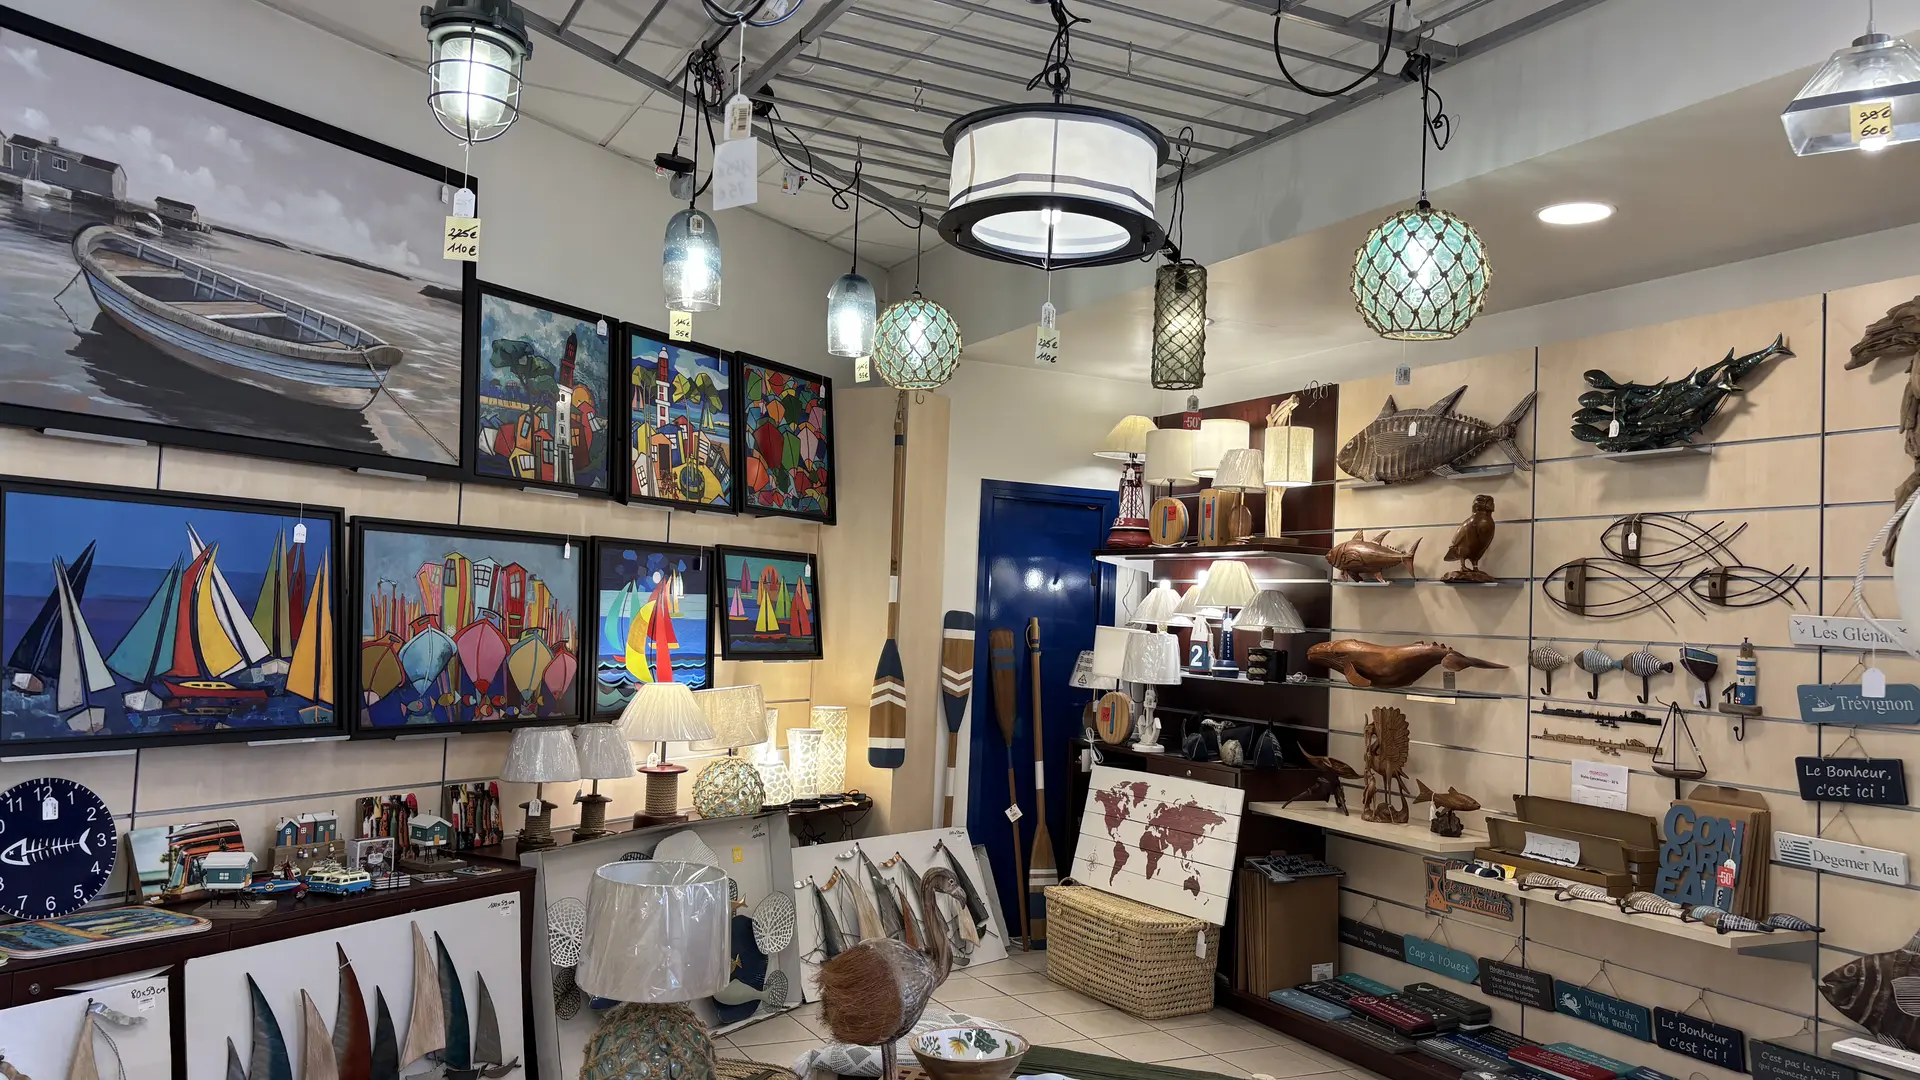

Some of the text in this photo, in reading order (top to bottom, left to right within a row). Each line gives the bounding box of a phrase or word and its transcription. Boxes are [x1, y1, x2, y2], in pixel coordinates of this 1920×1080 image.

[1861, 125, 1890, 136] 60€
[448, 226, 478, 240] 225€
[447, 243, 477, 256] 110€
[1037, 352, 1057, 363] 110€
[1812, 625, 1838, 640] Les
[1190, 645, 1203, 666] 2
[1837, 696, 1914, 714] Trévignon
[1805, 765, 1891, 780] Le Bonheur,
[67, 791, 74, 805] 1
[1816, 784, 1850, 797] c'est
[1857, 784, 1874, 798] ici
[6, 797, 23, 813] 11
[86, 807, 97, 821] 2
[1664, 805, 1745, 857] CON
[96, 833, 107, 847] 3
[90, 861, 101, 875] 4
[1813, 849, 1900, 877] Degemer Mat
[73, 884, 84, 899] 5
[17, 895, 28, 910] 7
[45, 896, 56, 911] 6
[1409, 945, 1470, 974] Cap à l'Ouest
[1608, 1003, 1617, 1016] les
[1589, 1008, 1596, 1019] la
[1598, 1012, 1609, 1024] Mer
[1612, 1019, 1633, 1033] monte
[1661, 1016, 1733, 1048] Le Bonheur,
[1669, 1037, 1698, 1054] c'est
[1703, 1044, 1718, 1060] ici
[1761, 1051, 1782, 1064] C'est
[1785, 1060, 1800, 1071] pas
[1803, 1061, 1811, 1072] le
[1814, 1065, 1840, 1079] Wi-Fi
